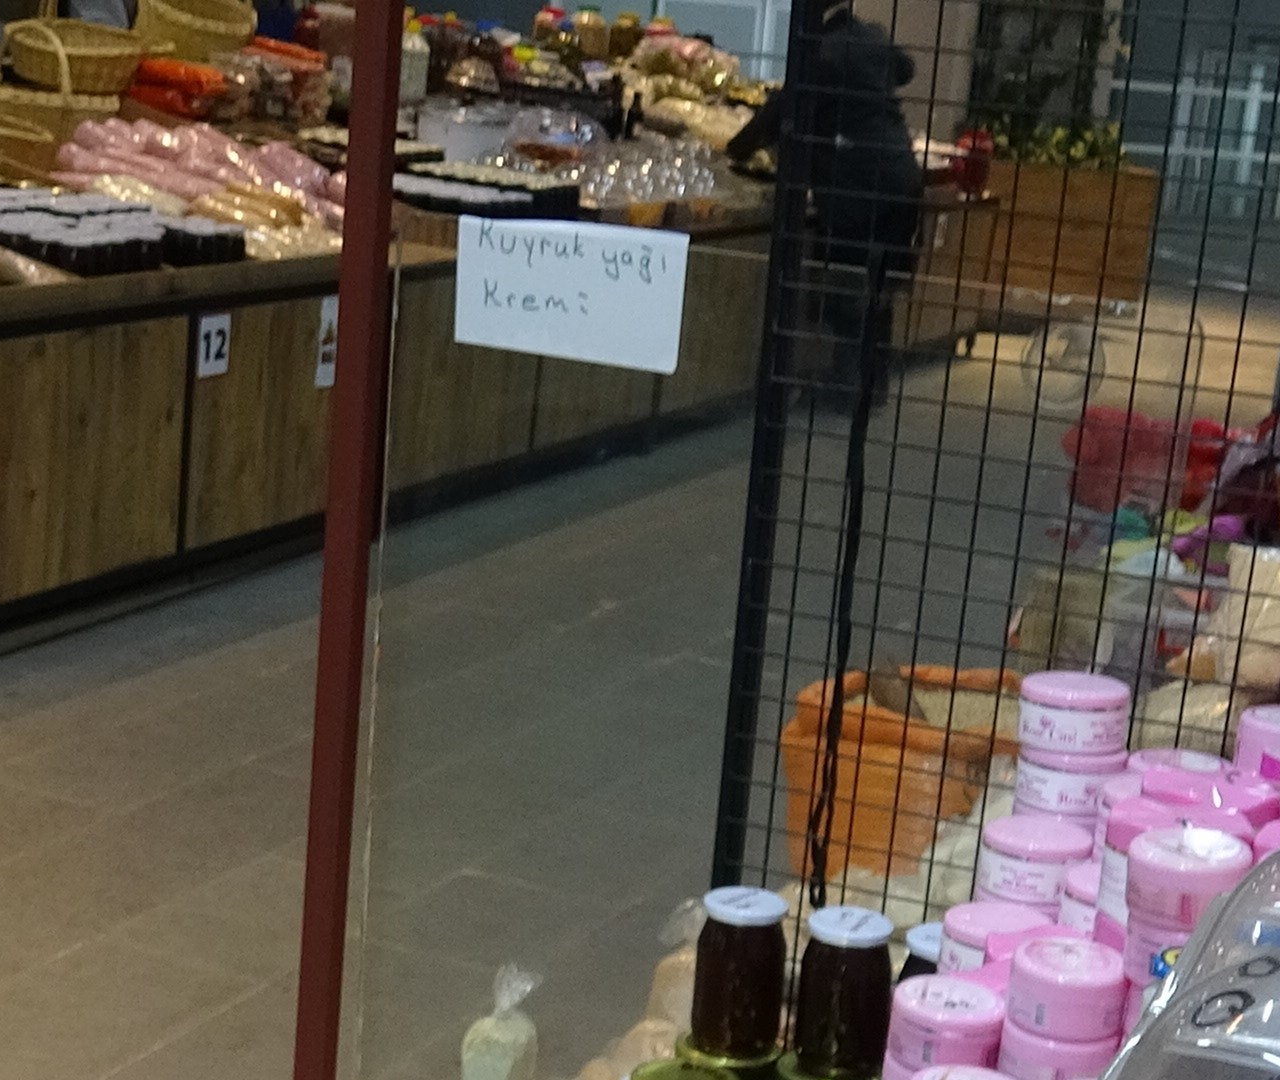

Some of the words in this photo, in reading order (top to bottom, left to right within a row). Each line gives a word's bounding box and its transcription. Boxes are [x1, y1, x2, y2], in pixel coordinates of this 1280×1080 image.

[478, 218, 585, 268] Kuyruk
[601, 244, 666, 284] yağı
[202, 328, 227, 362] 12
